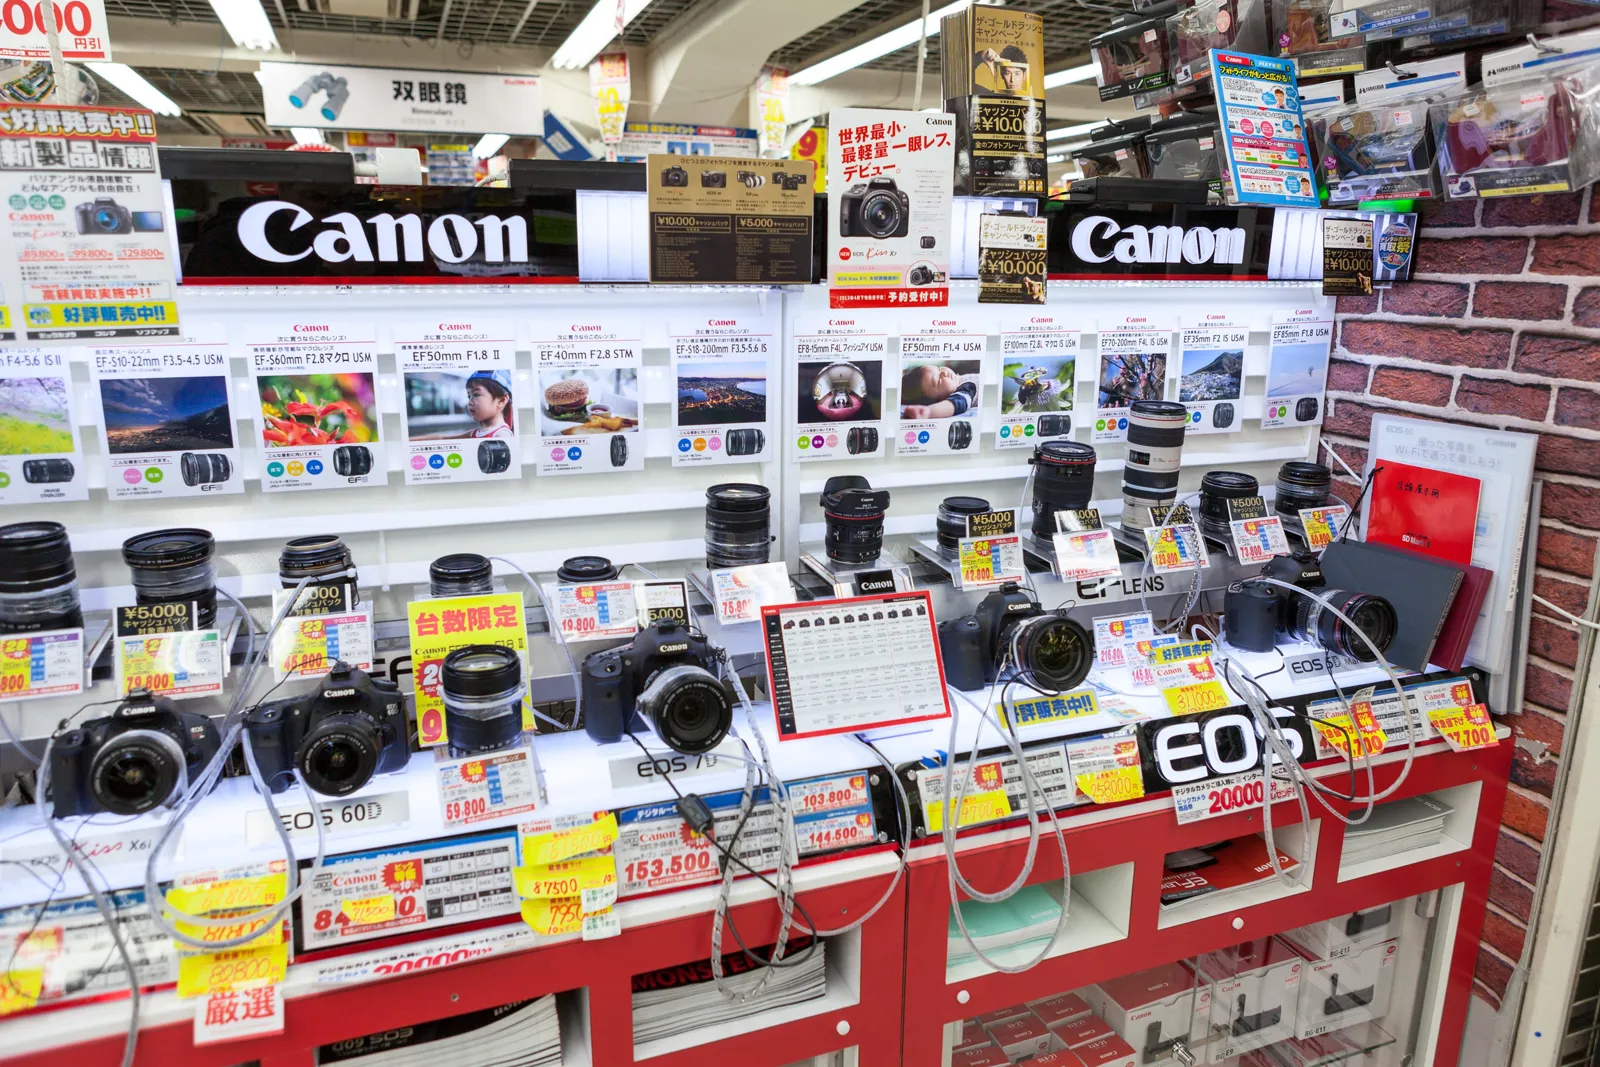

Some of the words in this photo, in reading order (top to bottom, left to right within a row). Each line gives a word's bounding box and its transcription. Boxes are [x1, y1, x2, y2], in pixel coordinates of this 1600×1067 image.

[975, 16, 1043, 34] ザ・ゴールドラッシュ
[976, 27, 1022, 39] キャンペーン
[74, 38, 101, 49] 円引
[1225, 55, 1242, 64] Canon
[392, 80, 468, 104] 双眼鏡
[411, 107, 453, 116] Binoculars
[925, 117, 953, 126] Canon
[1, 138, 154, 170] 新製品情報
[841, 141, 888, 164] 最軽量
[843, 162, 901, 182] デビュー。
[9, 212, 55, 221] Canon
[237, 200, 529, 263] Canon
[1071, 215, 1246, 265] Canon
[987, 260, 1046, 275] ¥10,000
[888, 291, 943, 302] 予約受付中!
[708, 318, 736, 327] Canon
[1031, 316, 1053, 324] Canon
[293, 324, 329, 333] Canon
[438, 323, 472, 331] Canon
[571, 324, 602, 332] Canon
[1183, 335, 1211, 344] EF35mm
[1213, 335, 1221, 343] F2
[1230, 334, 1245, 342] USM
[1273, 330, 1300, 339] EF85mm
[1315, 328, 1329, 337] USM
[797, 344, 830, 353] EF8-15mm
[870, 343, 883, 352] USM
[902, 343, 940, 352] EF50mm
[943, 343, 960, 352] F1.4
[963, 342, 982, 351] USM
[1004, 340, 1029, 349] EF100mm
[1065, 339, 1076, 347] USM
[1101, 338, 1137, 347] EF70-200mm
[1156, 338, 1168, 346] USM
[590, 349, 611, 359] F2.8
[613, 349, 633, 359] STM
[676, 344, 728, 354] EF-S18-200mm
[731, 343, 759, 353] F3.5-5.6
[7, 354, 40, 367] F4-5.6
[96, 356, 160, 368] EF-S10-22mm
[163, 355, 201, 366] F3.5-4.5
[204, 354, 224, 366] USM
[254, 354, 303, 366] EF-S60mm
[306, 352, 350, 364] F2.8マクロ
[352, 352, 372, 364] USM
[412, 351, 462, 362] EF50mm
[466, 350, 488, 361] F1.8
[1386, 425, 1403, 435] EOS
[1485, 437, 1517, 449] Canon
[973, 511, 1011, 525] ¥5,000
[972, 521, 1013, 532] キャッシュバック
[977, 541, 989, 551] 26
[1302, 570, 1320, 578] Canon
[861, 579, 893, 591] Canon
[1123, 576, 1165, 595] LENS
[124, 603, 187, 619] ¥5,000
[1007, 602, 1031, 612] Canon
[123, 616, 189, 628] キャッシュバック
[415, 604, 519, 637] 台数限定
[561, 616, 595, 632] 19,800
[304, 620, 323, 633] 23
[414, 646, 446, 656] Canon
[659, 643, 688, 653] Canon
[1156, 667, 1183, 677] Canon
[1291, 660, 1324, 674] EOS
[324, 688, 356, 698] Canon
[1424, 693, 1446, 701] Canon
[122, 705, 156, 716] Canon
[1325, 710, 1349, 719] Canon
[1153, 705, 1304, 783] EOS
[637, 755, 687, 777] EOS
[803, 788, 851, 808] 103,800
[1176, 794, 1206, 806] ビックカメラ
[1209, 780, 1265, 814] 20,000
[446, 797, 486, 820] 59,800
[280, 808, 334, 833] EOS
[341, 801, 383, 822] 60D
[522, 824, 552, 834] Canon
[639, 830, 676, 843] Canon
[128, 838, 152, 852] X6i
[624, 851, 711, 883] 153,500
[182, 875, 218, 886] Canon
[333, 873, 377, 887] Canon
[1031, 907, 1062, 921] Canon
[1329, 945, 1351, 958] BG-E13
[1313, 962, 1333, 972] Canon
[204, 985, 276, 1026] 厳選
[1130, 1010, 1153, 1021] Canon
[1014, 1030, 1033, 1039] Canon
[1078, 1029, 1096, 1038] Canon
[1304, 1025, 1327, 1037] BG-E11
[1099, 1050, 1118, 1060] Canon
